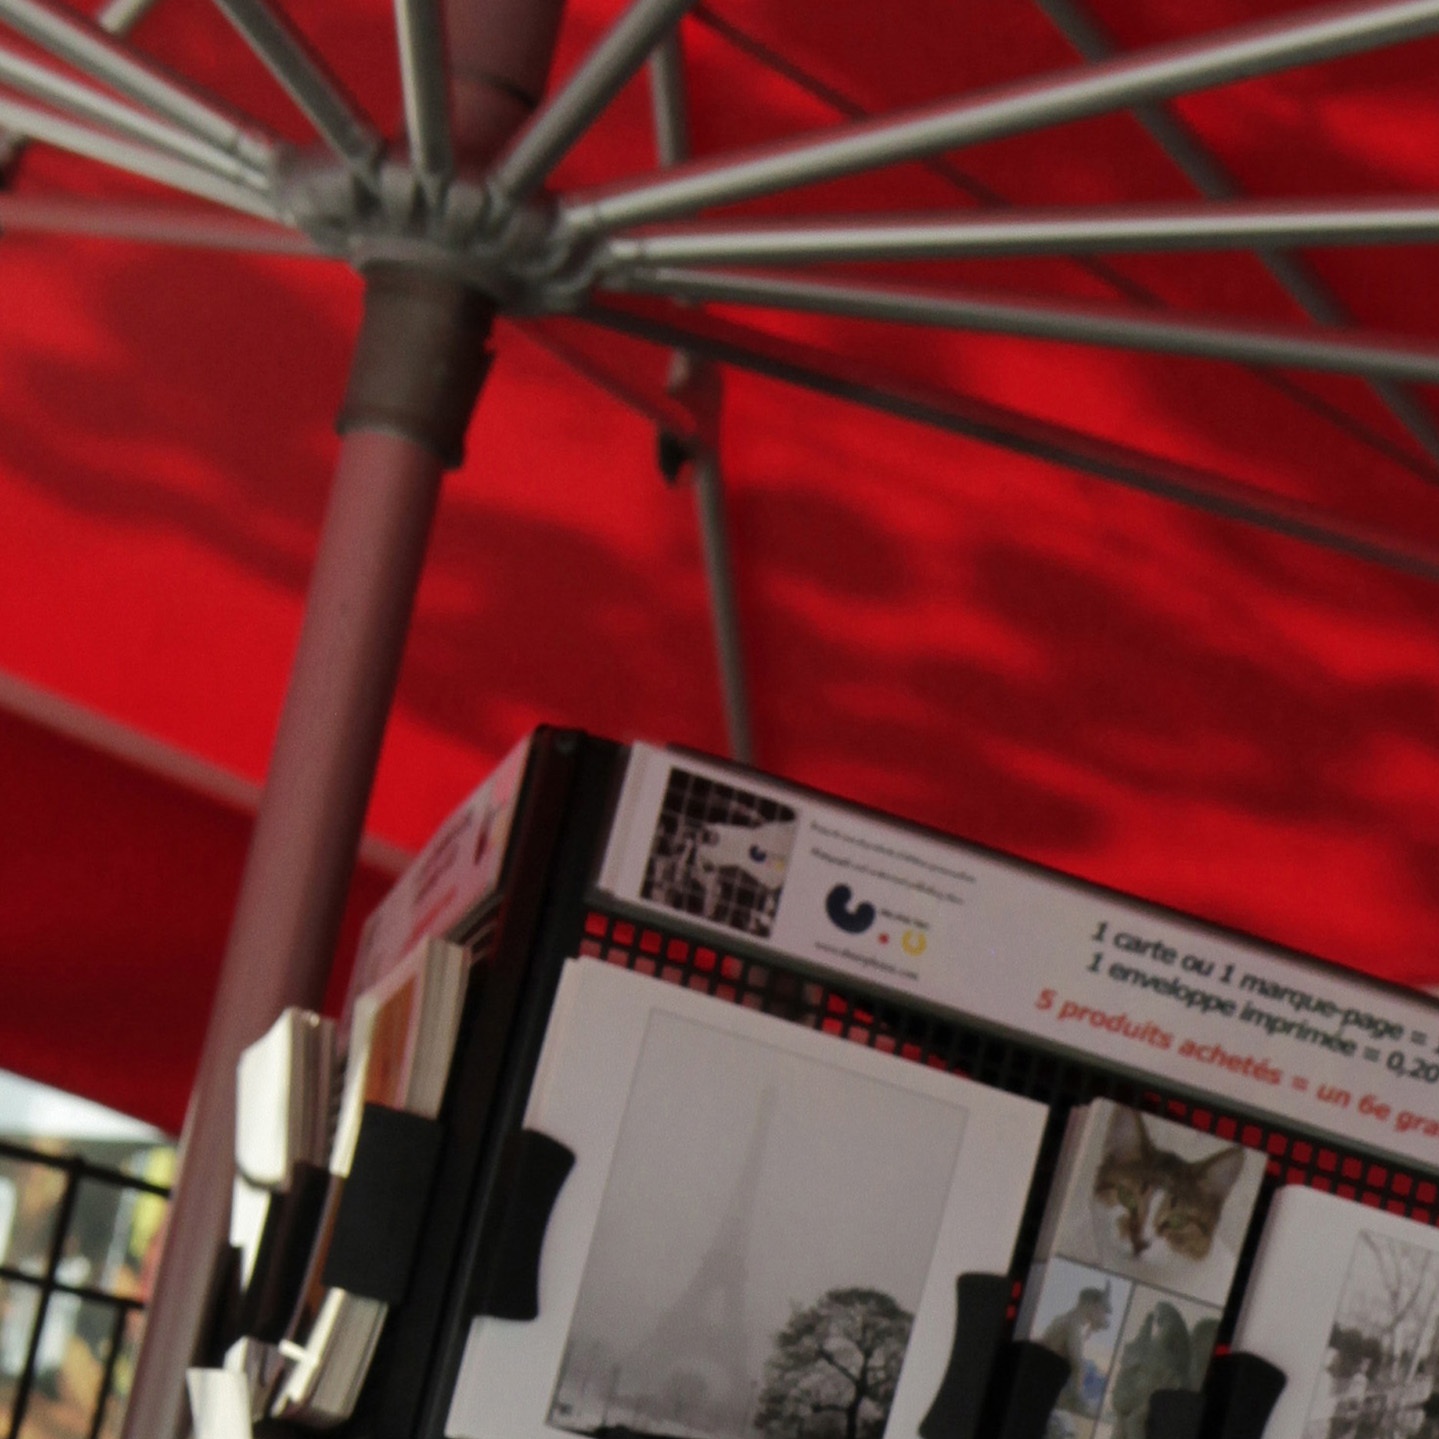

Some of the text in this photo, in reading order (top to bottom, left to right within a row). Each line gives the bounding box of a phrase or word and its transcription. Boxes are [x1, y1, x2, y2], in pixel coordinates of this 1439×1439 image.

[1087, 952, 1103, 973] 1
[1108, 962, 1237, 1016] enveloppe
[1239, 1000, 1357, 1056] imprimée
[1092, 921, 1108, 942] 1
[1113, 931, 1177, 964] carte
[1181, 953, 1215, 977] ou
[1219, 963, 1235, 984] 1
[1239, 972, 1404, 1039] marque-page
[1035, 987, 1058, 1010] 5
[1057, 1000, 1174, 1050] produits
[1177, 1038, 1283, 1087] achetés
[1316, 1083, 1351, 1108] un
[1357, 1094, 1391, 1121] 6e
